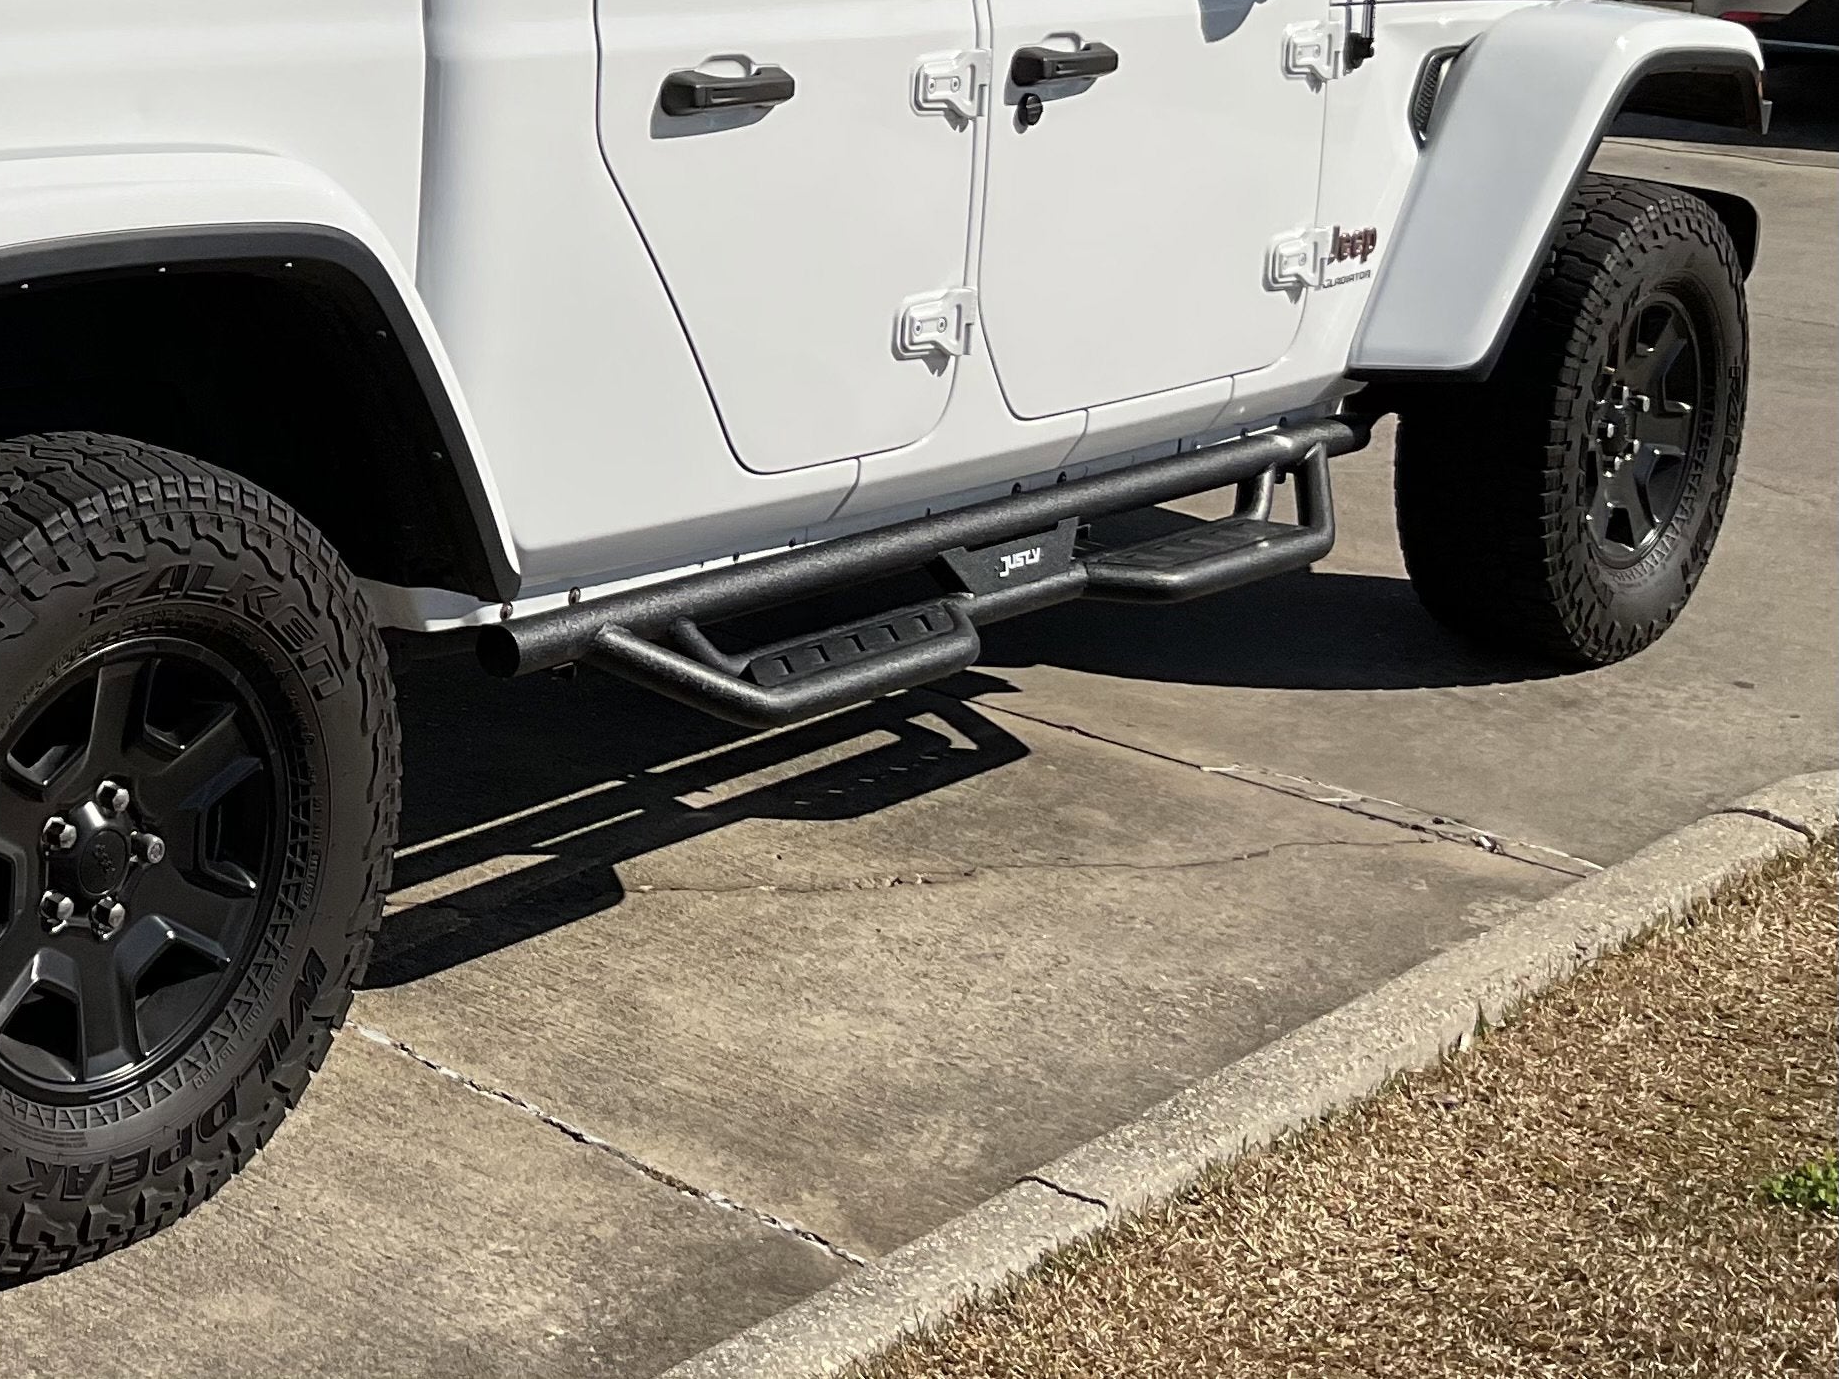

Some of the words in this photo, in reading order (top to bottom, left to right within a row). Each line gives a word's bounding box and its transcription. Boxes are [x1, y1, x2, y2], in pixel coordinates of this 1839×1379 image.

[1327, 224, 1377, 264] Jeep
[88, 562, 344, 702] FALKEN
[7, 946, 328, 1201] WILDPEAK
